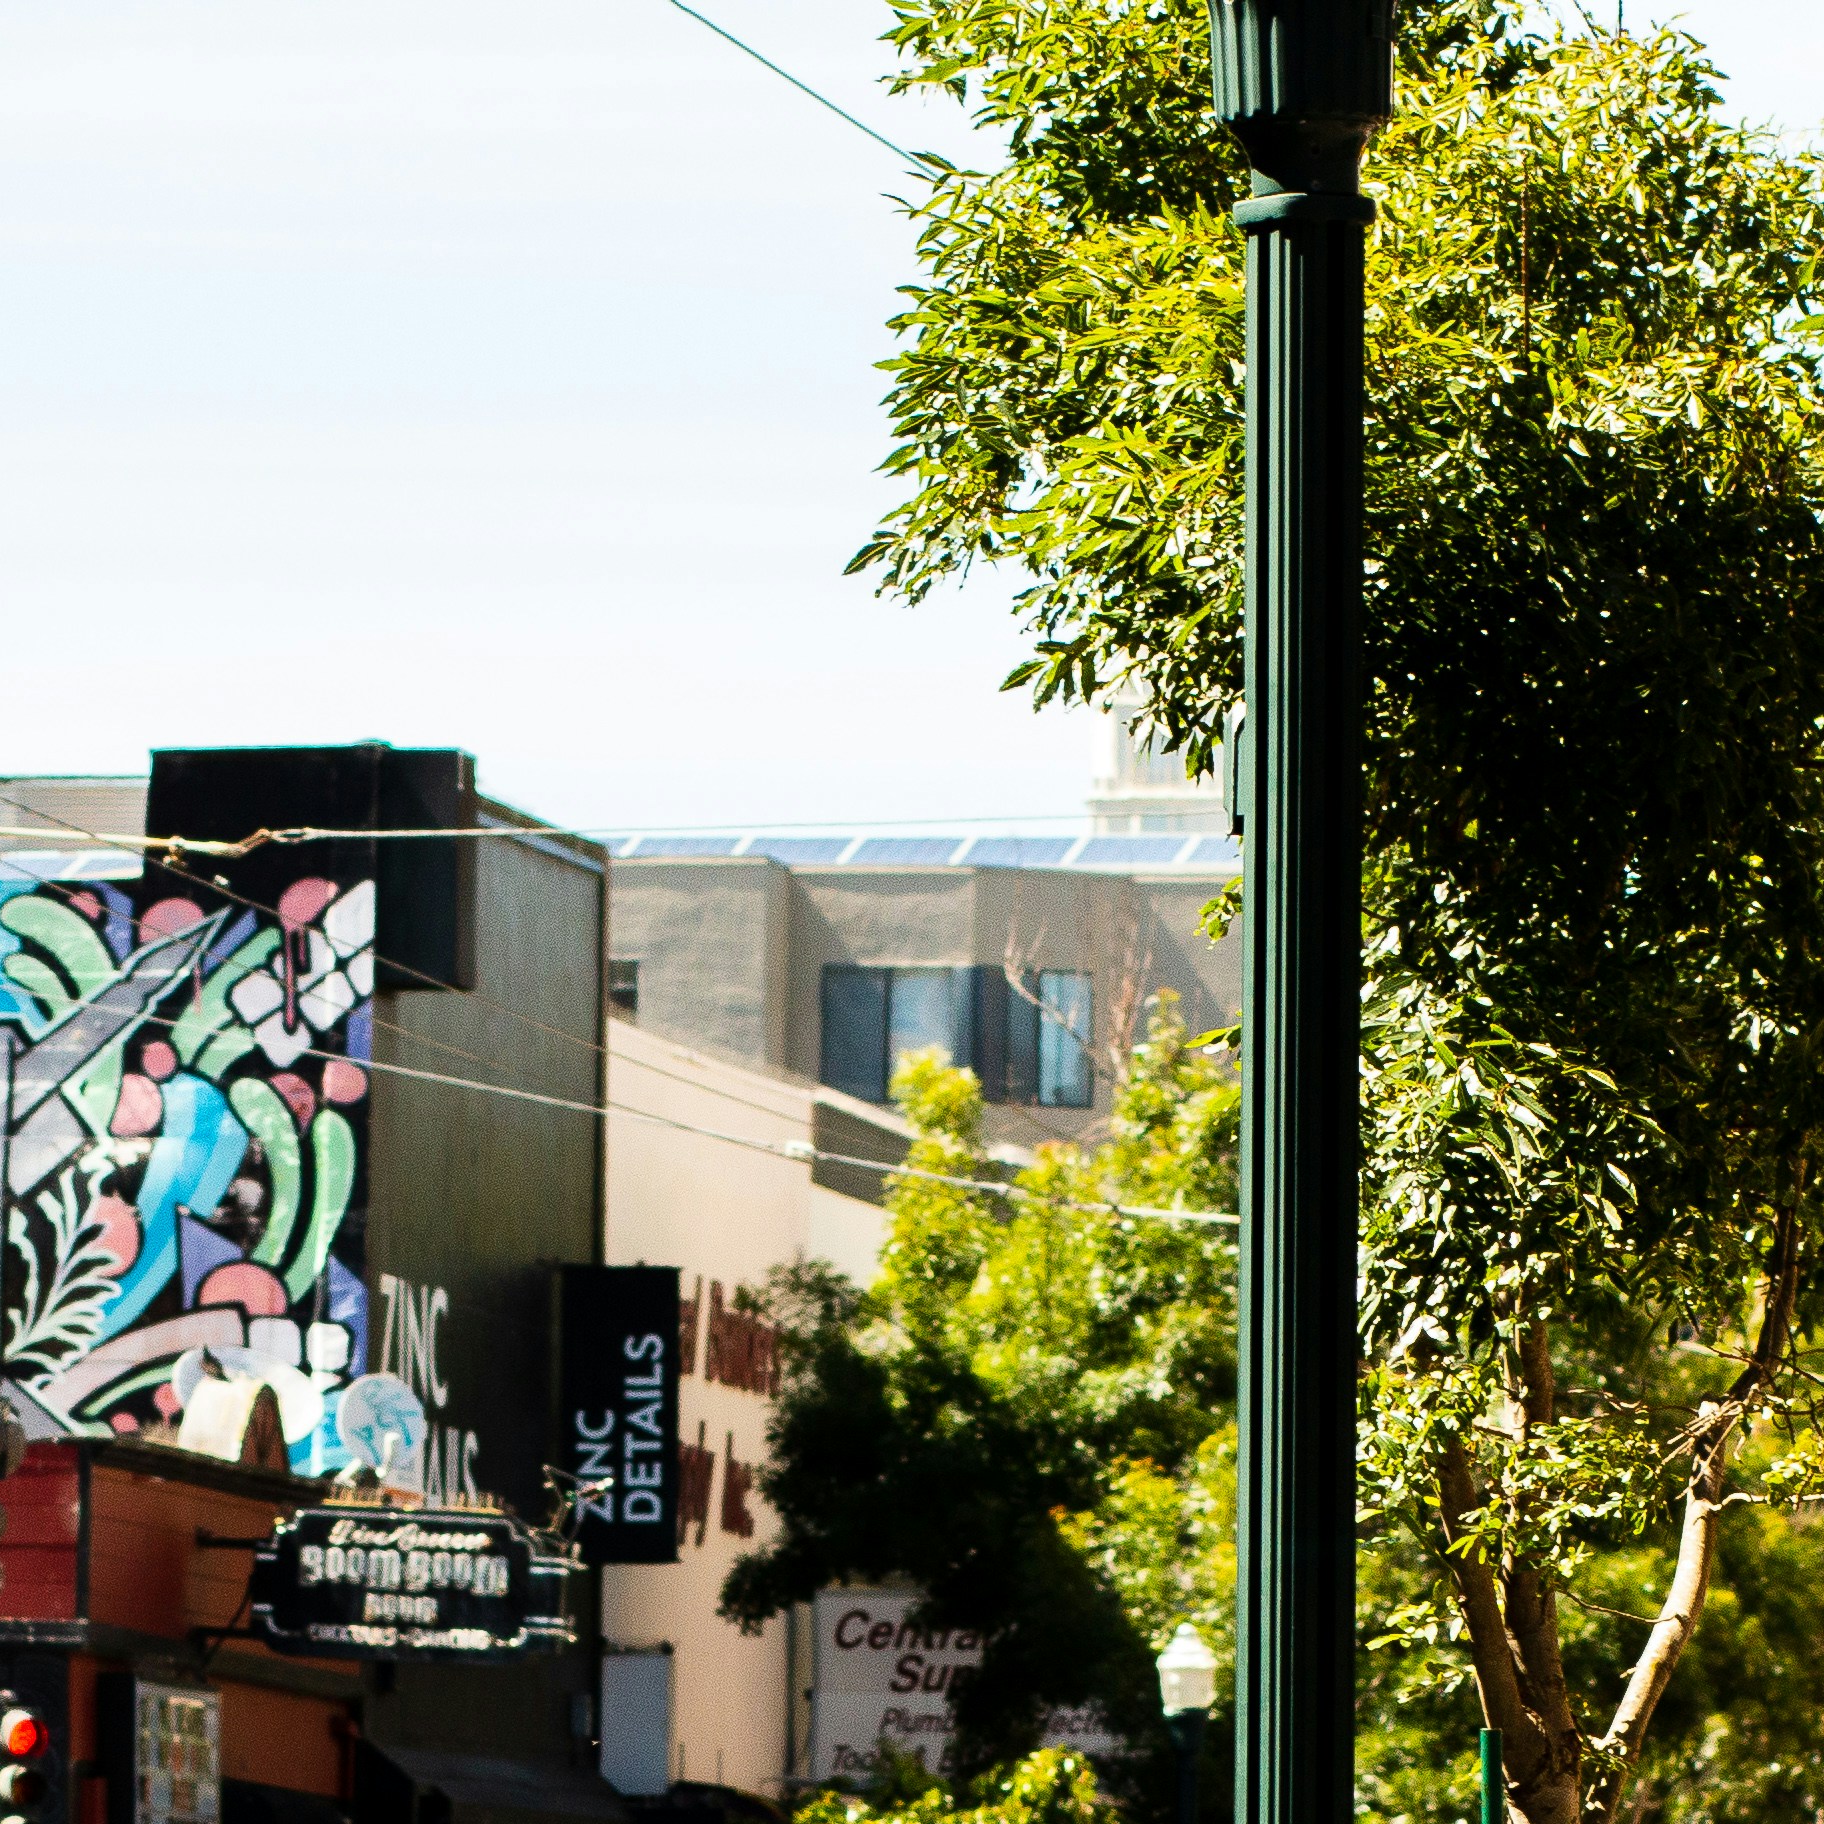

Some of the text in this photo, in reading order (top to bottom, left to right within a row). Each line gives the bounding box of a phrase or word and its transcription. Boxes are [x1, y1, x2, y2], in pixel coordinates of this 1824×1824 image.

[575, 1408, 616, 1523] ZINC
[623, 1332, 665, 1524] DETAILS
[834, 1610, 992, 1652] Centra
